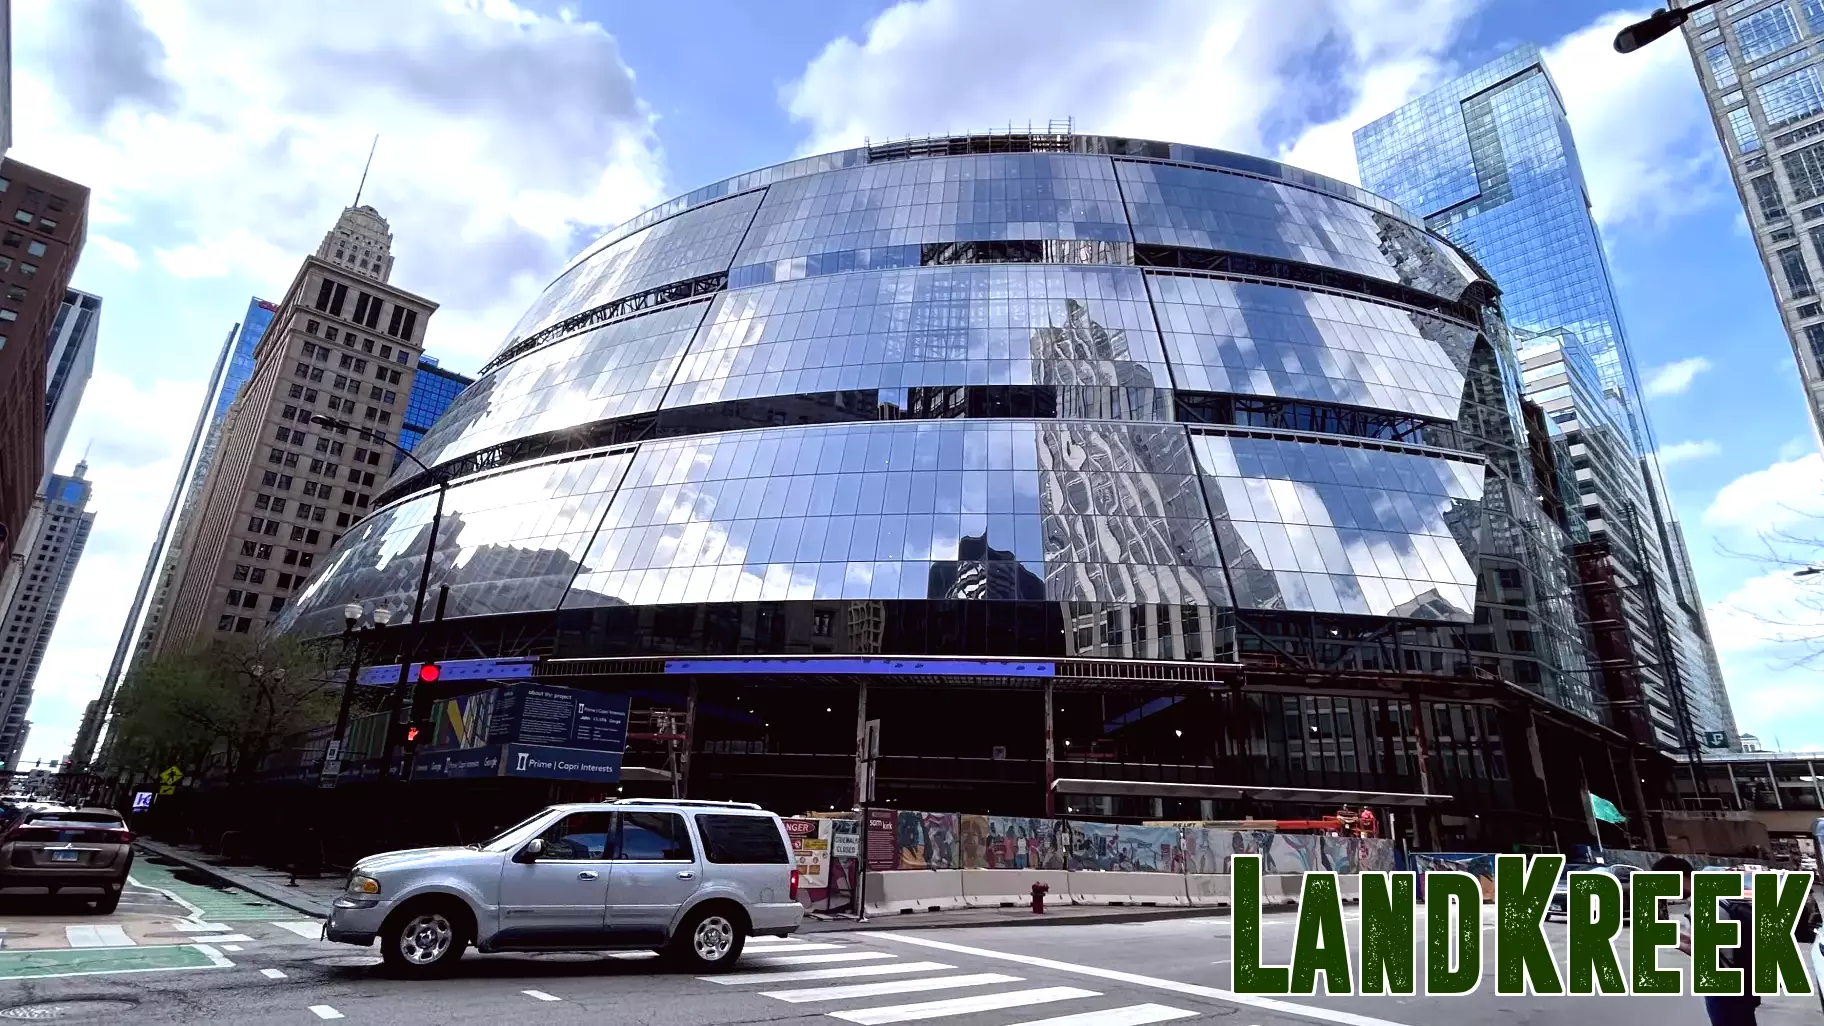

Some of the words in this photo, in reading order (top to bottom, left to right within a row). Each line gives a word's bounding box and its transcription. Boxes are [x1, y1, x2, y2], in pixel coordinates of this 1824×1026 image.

[528, 759, 553, 769] Prime
[557, 761, 580, 772] Capri
[580, 763, 613, 773] Interests
[869, 819, 883, 827] sam
[836, 845, 856, 853] CLOSED
